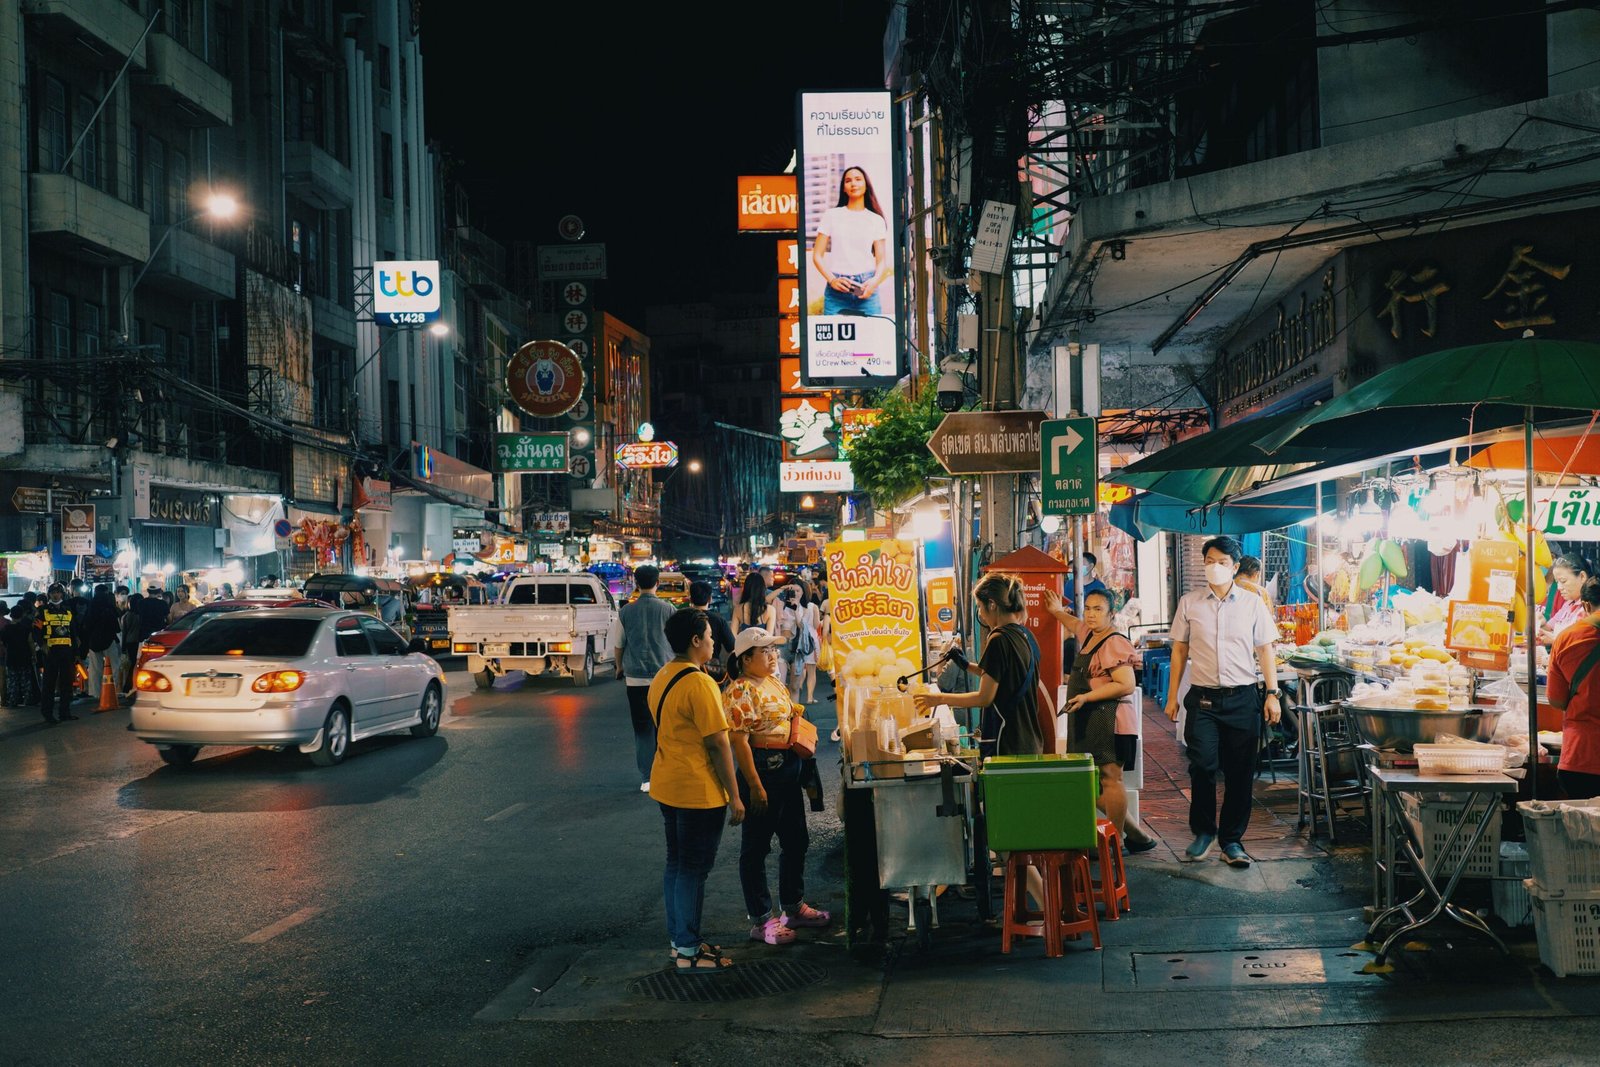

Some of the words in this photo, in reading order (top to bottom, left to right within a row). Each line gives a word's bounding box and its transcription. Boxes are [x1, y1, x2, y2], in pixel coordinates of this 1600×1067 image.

[810, 108, 885, 121] ความเรียบง่าย
[816, 123, 879, 136] ที่ไม่ธรรมดา
[379, 270, 433, 297] ttb
[399, 313, 425, 323] 1428
[841, 325, 852, 339] U
[497, 436, 564, 458] ฉ.มั่นคง
[941, 433, 971, 463] สุดเขต
[1055, 478, 1082, 491] ตลาด
[1048, 496, 1090, 512] กรมภูธเรศ
[830, 550, 914, 592] น้ำลำไย
[834, 592, 915, 624] พัชร์ลิตา
[839, 630, 870, 641] หวานหอม
[893, 627, 910, 636] ชื่นใจ
[1488, 632, 1508, 645] 100
